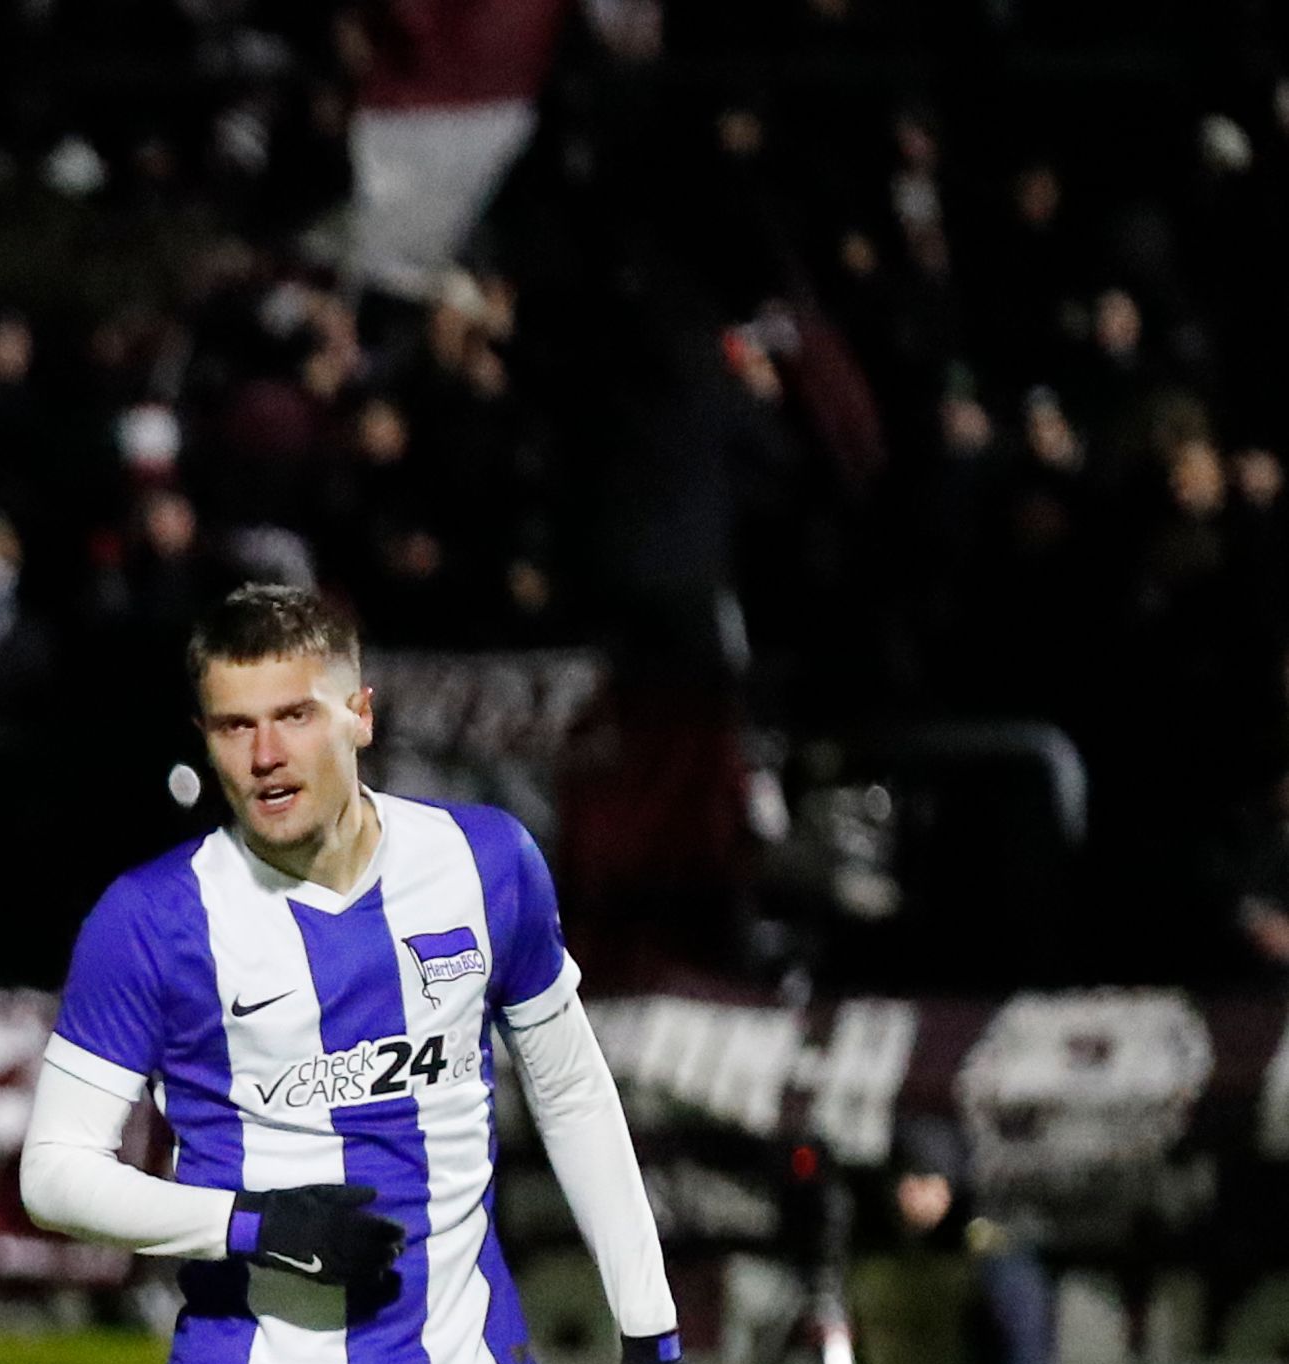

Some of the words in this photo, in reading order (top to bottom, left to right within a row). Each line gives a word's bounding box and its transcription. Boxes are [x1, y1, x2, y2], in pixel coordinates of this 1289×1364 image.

[425, 959, 464, 980] Hertha
[461, 951, 483, 971] BSC
[298, 1047, 375, 1083] check
[285, 1073, 365, 1108] CARS
